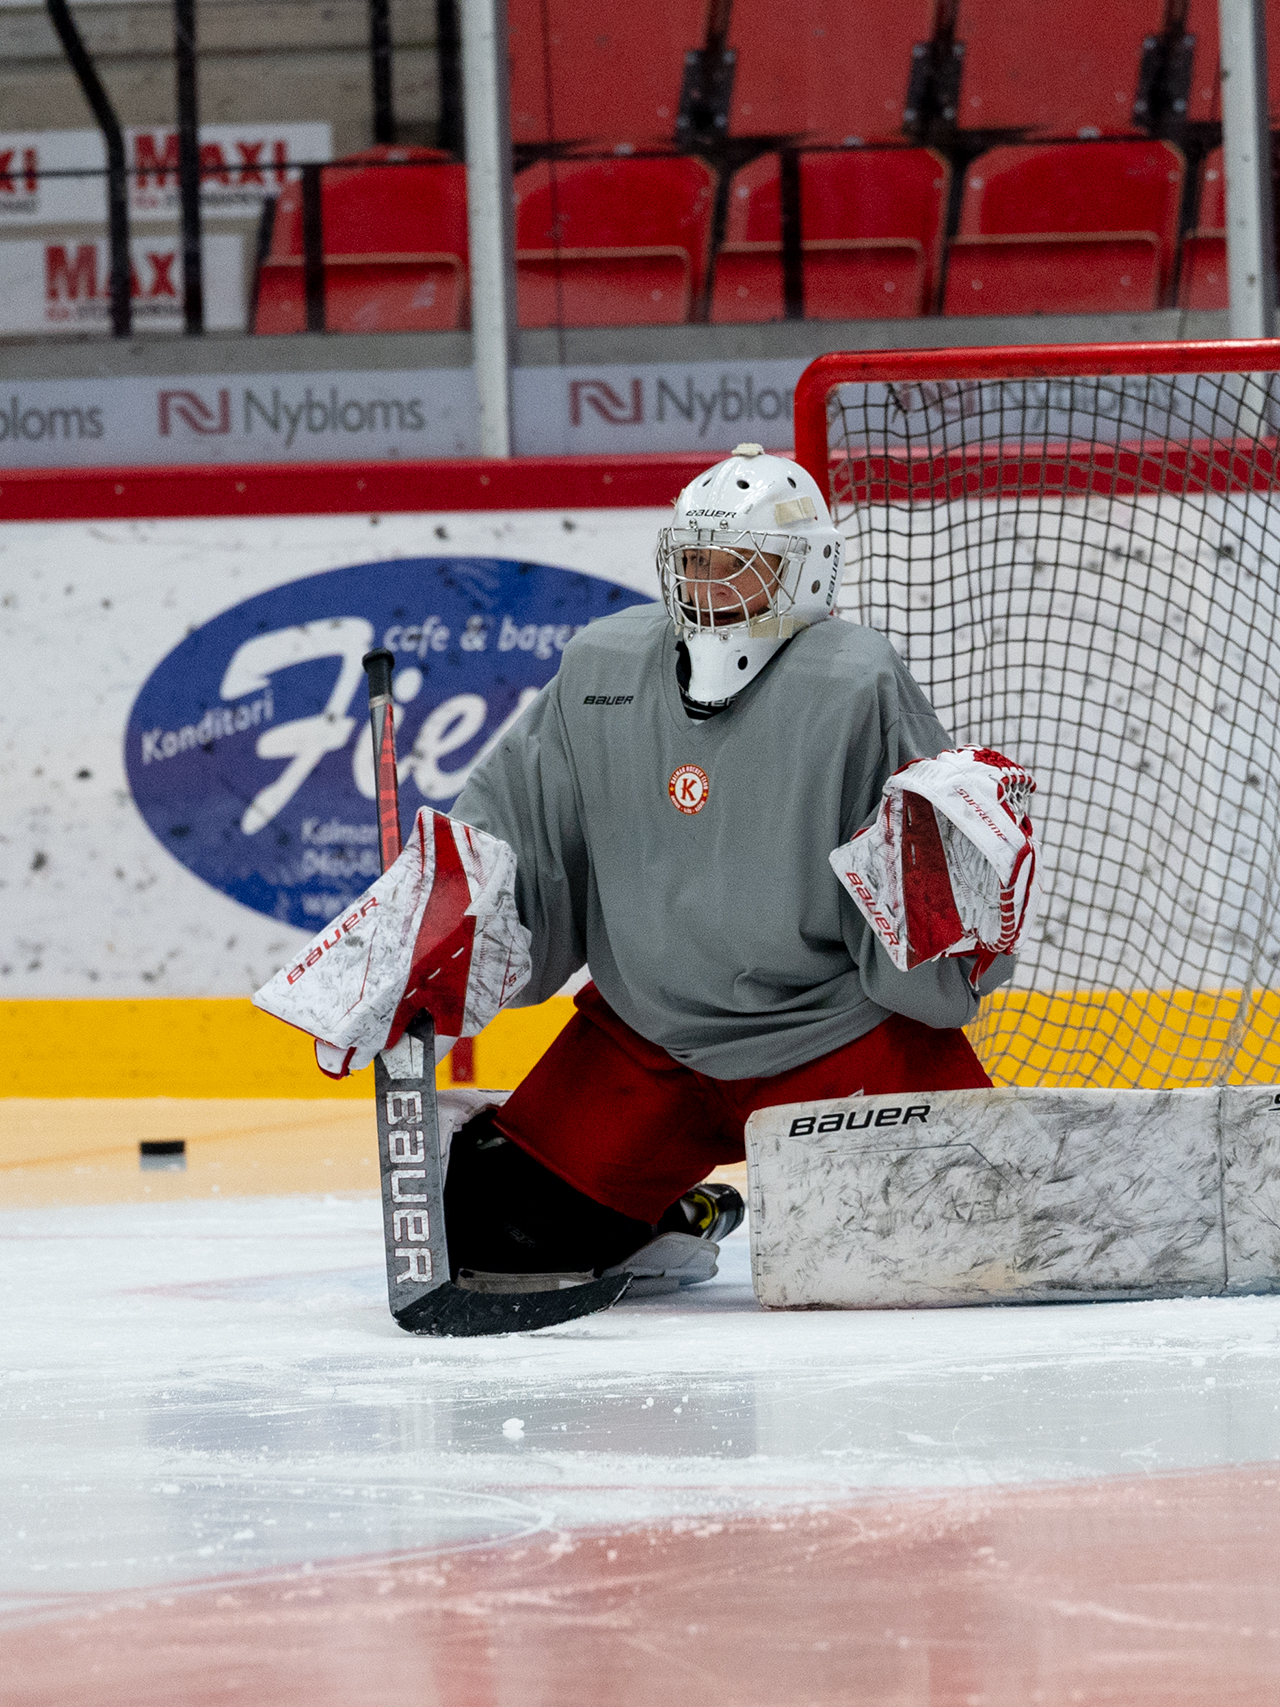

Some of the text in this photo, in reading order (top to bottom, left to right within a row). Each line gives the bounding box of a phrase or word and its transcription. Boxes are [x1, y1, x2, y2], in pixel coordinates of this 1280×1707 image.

[45, 245, 177, 301] MAX
[244, 386, 427, 450] Nybloms
[655, 373, 797, 437] Nyblo
[685, 508, 737, 519] BAUER
[825, 541, 841, 607] BAUER
[497, 614, 592, 660] bage
[141, 686, 274, 766] Konditori
[219, 616, 546, 836] Fie
[583, 695, 634, 706] BAUER
[680, 778, 698, 802] K
[954, 787, 1009, 842] SUPREME
[286, 896, 380, 986] BAUER
[845, 871, 900, 947] BAUER
[788, 1103, 932, 1138] BAUER
[385, 1090, 434, 1285] BAUER
